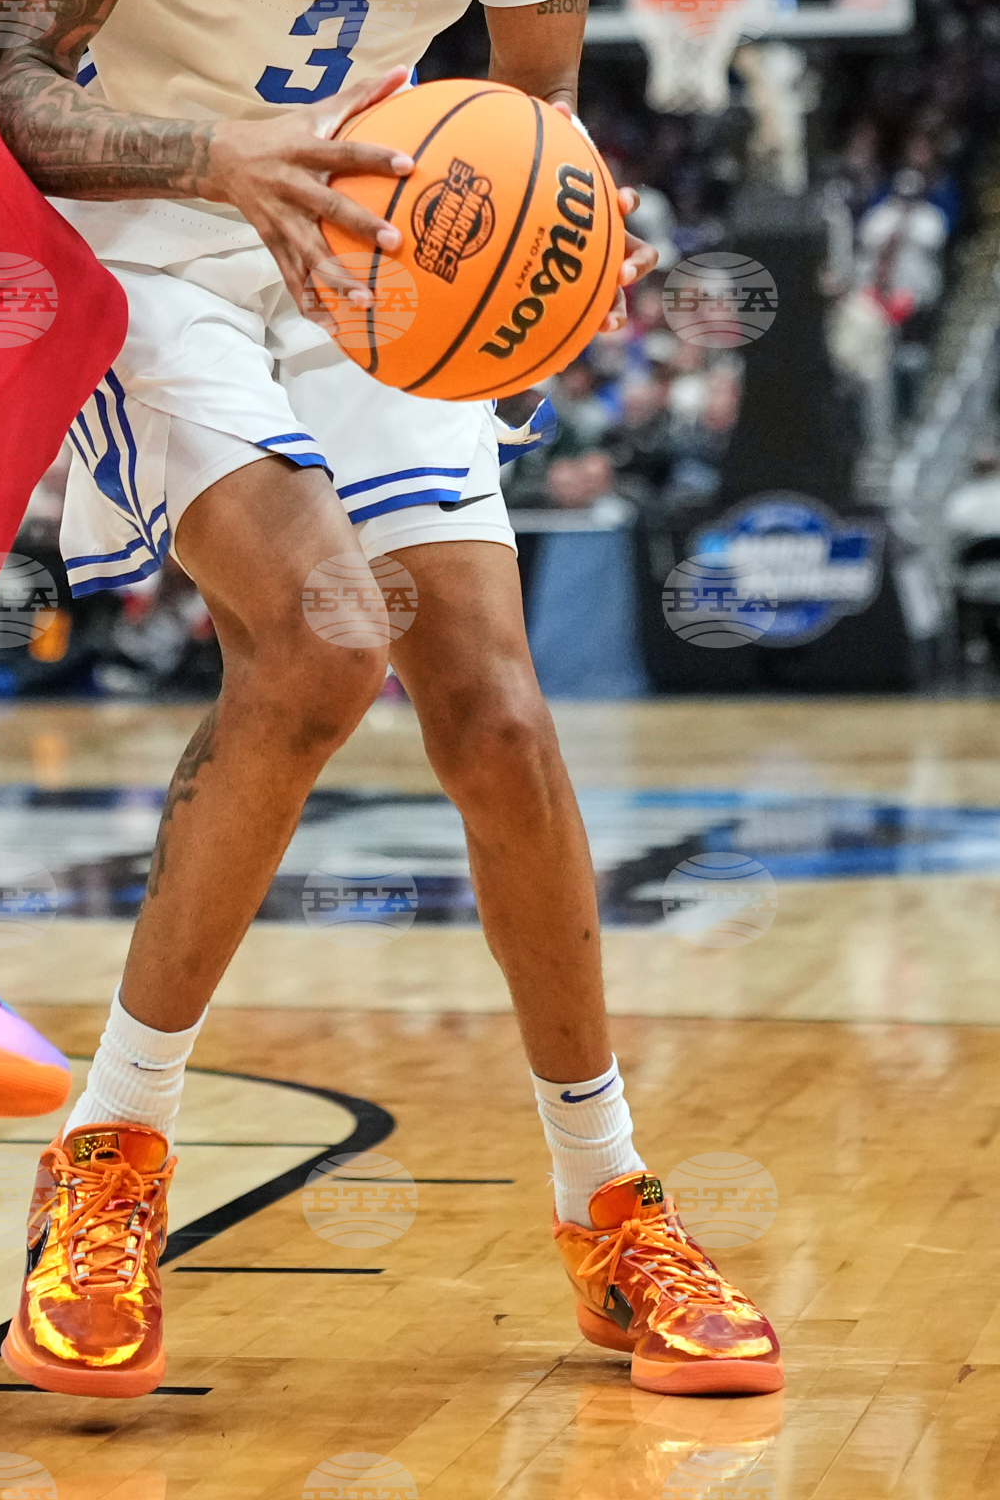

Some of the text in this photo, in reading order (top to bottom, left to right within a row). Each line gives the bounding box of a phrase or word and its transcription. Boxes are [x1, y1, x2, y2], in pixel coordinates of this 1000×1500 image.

[419, 188, 463, 271] MADNESS
[445, 191, 483, 255] MARCH
[478, 163, 596, 360] Wilson
